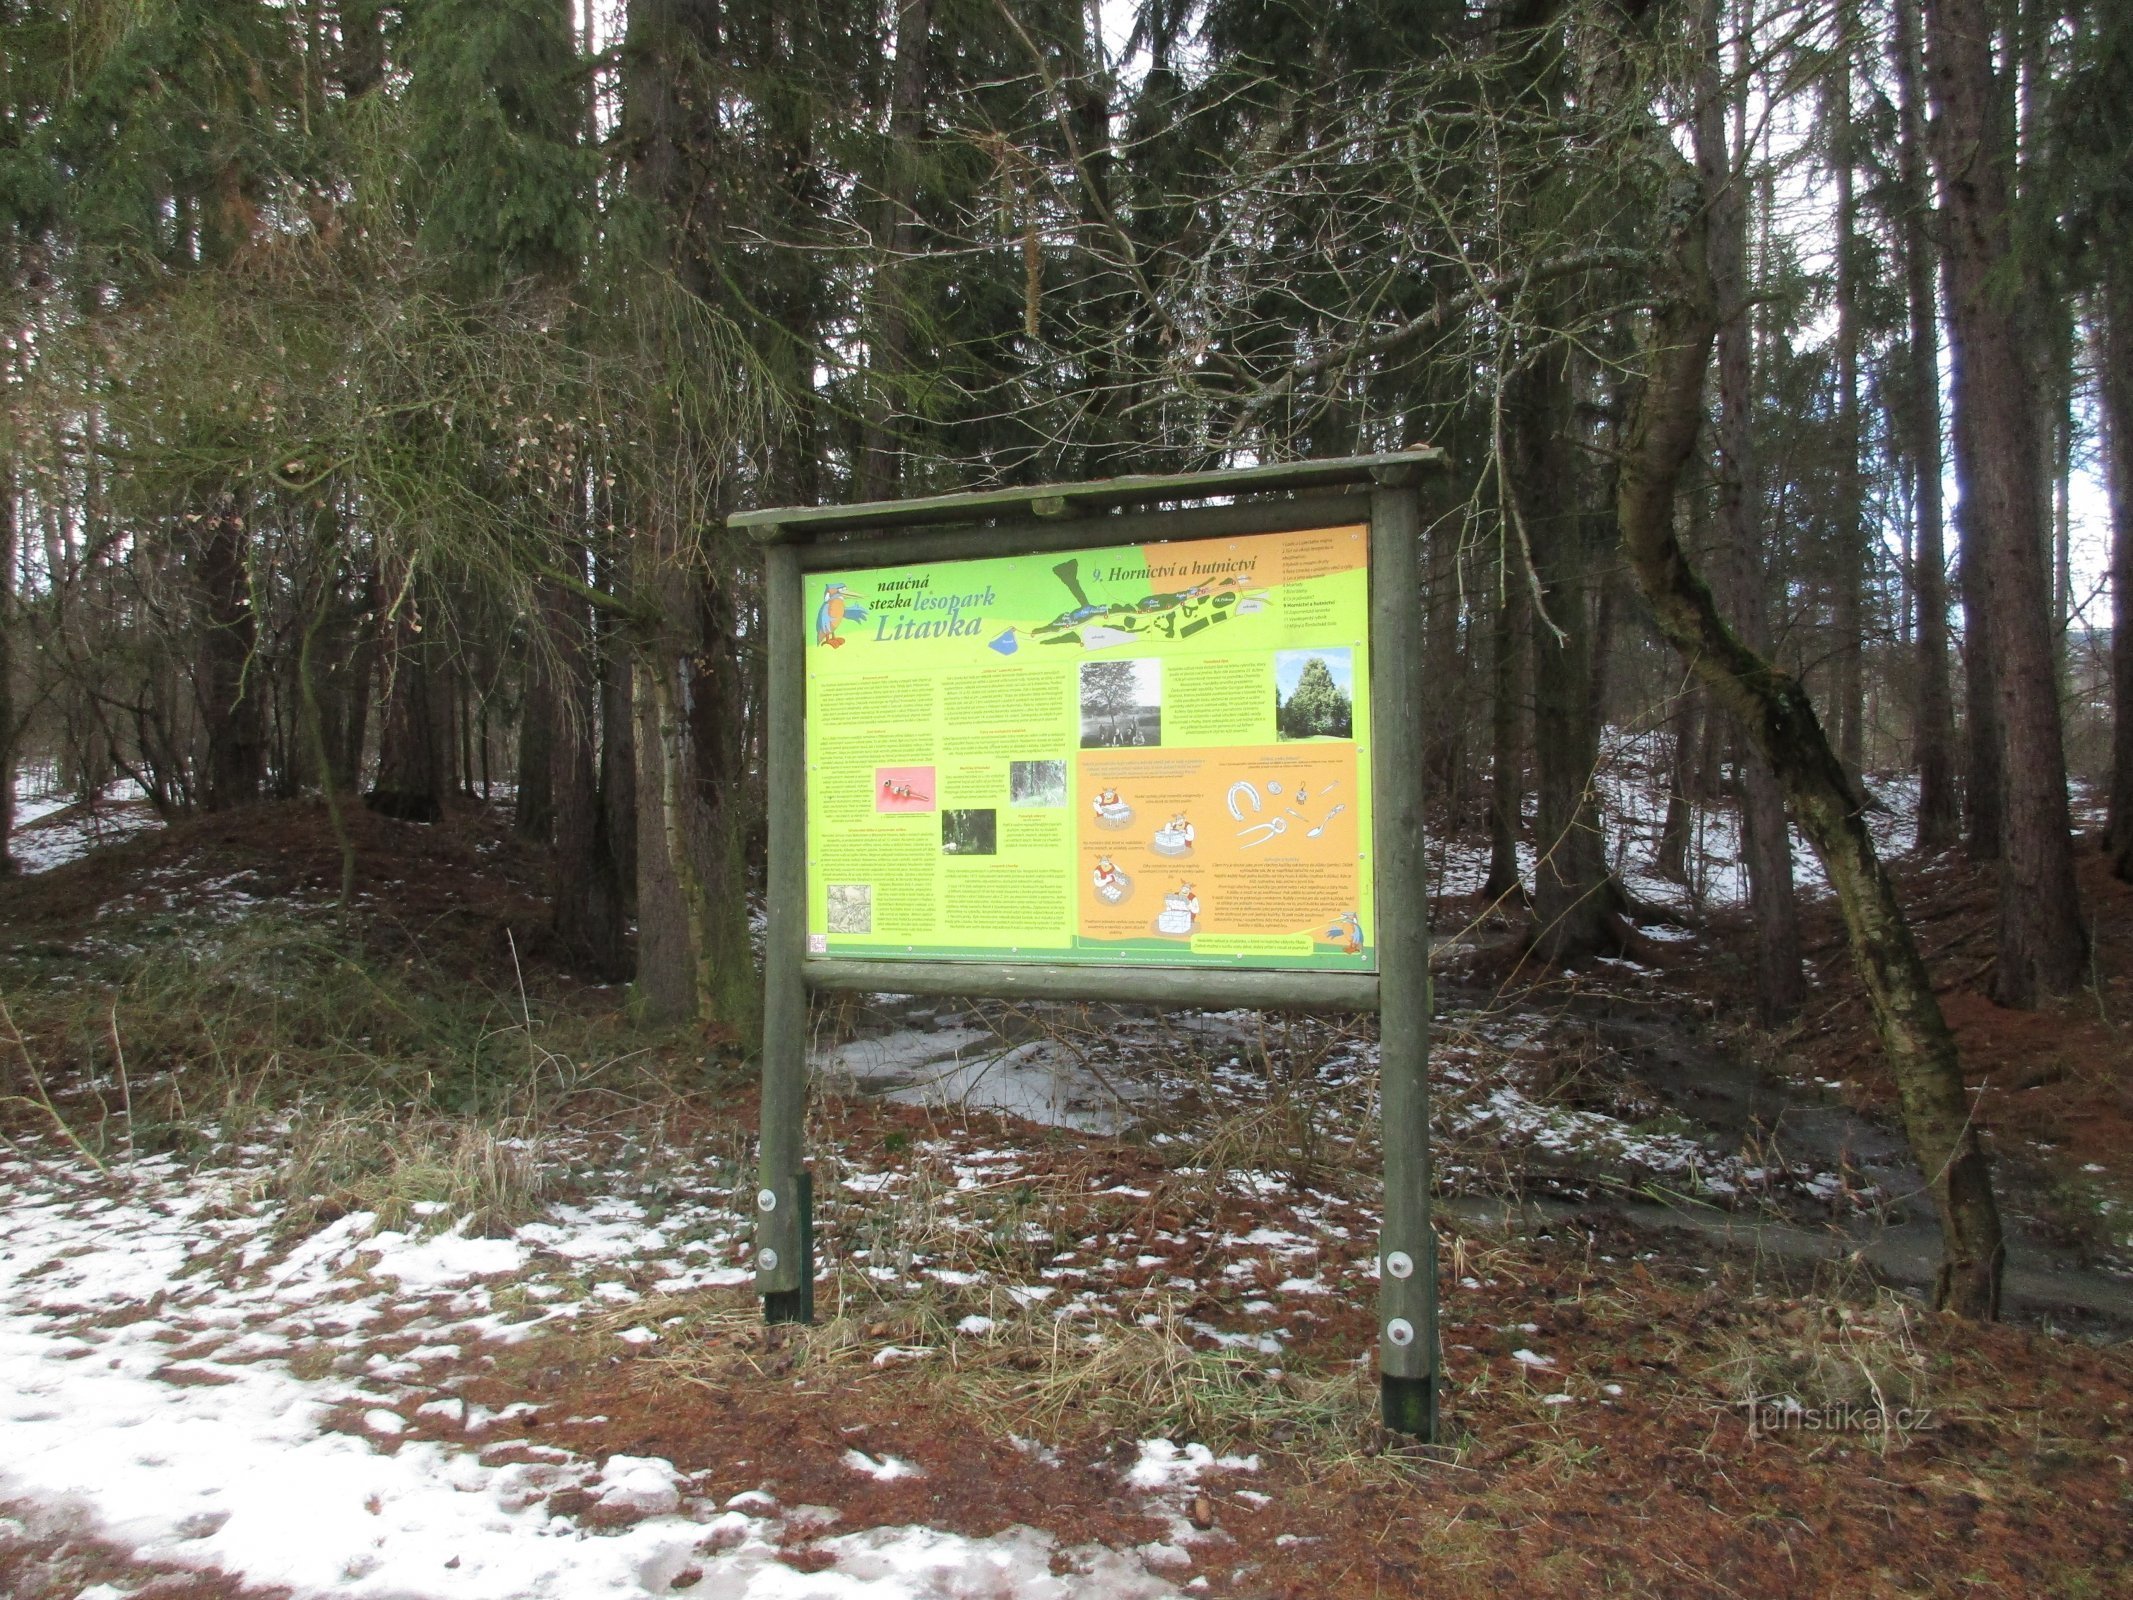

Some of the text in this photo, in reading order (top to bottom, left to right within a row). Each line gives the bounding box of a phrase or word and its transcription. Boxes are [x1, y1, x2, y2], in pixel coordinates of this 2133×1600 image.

[877, 573, 930, 592] naučná
[1092, 555, 1258, 583] 9. Hornictví a hutnictví
[869, 585, 996, 615] stezka lesopark
[873, 607, 983, 642] Litavka
